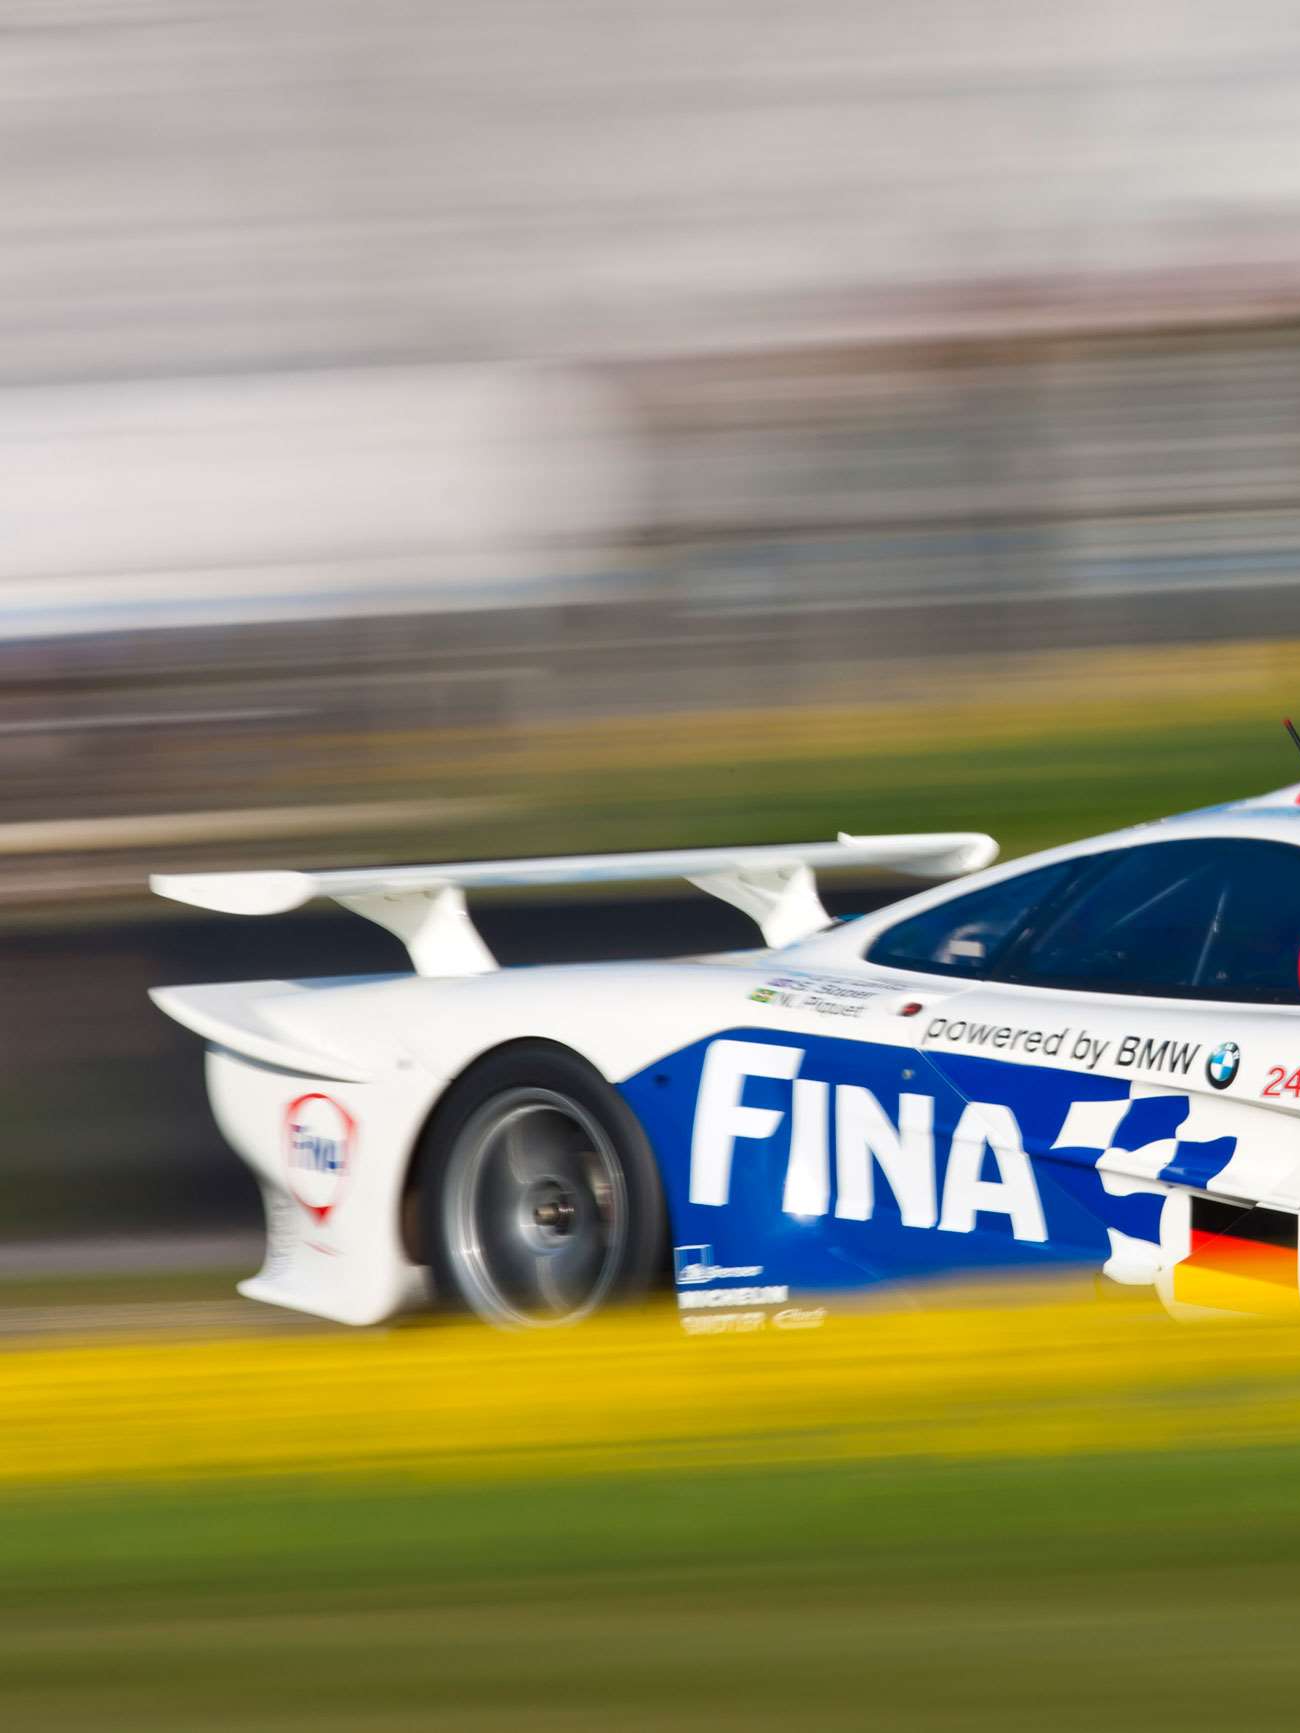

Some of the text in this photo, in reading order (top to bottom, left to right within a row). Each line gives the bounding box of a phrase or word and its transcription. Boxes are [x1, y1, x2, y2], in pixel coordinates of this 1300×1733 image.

[921, 1016, 1070, 1056] powered
[1070, 1029, 1111, 1070] by
[1115, 1036, 1200, 1075] BMW
[689, 1039, 1049, 1243] FINA
